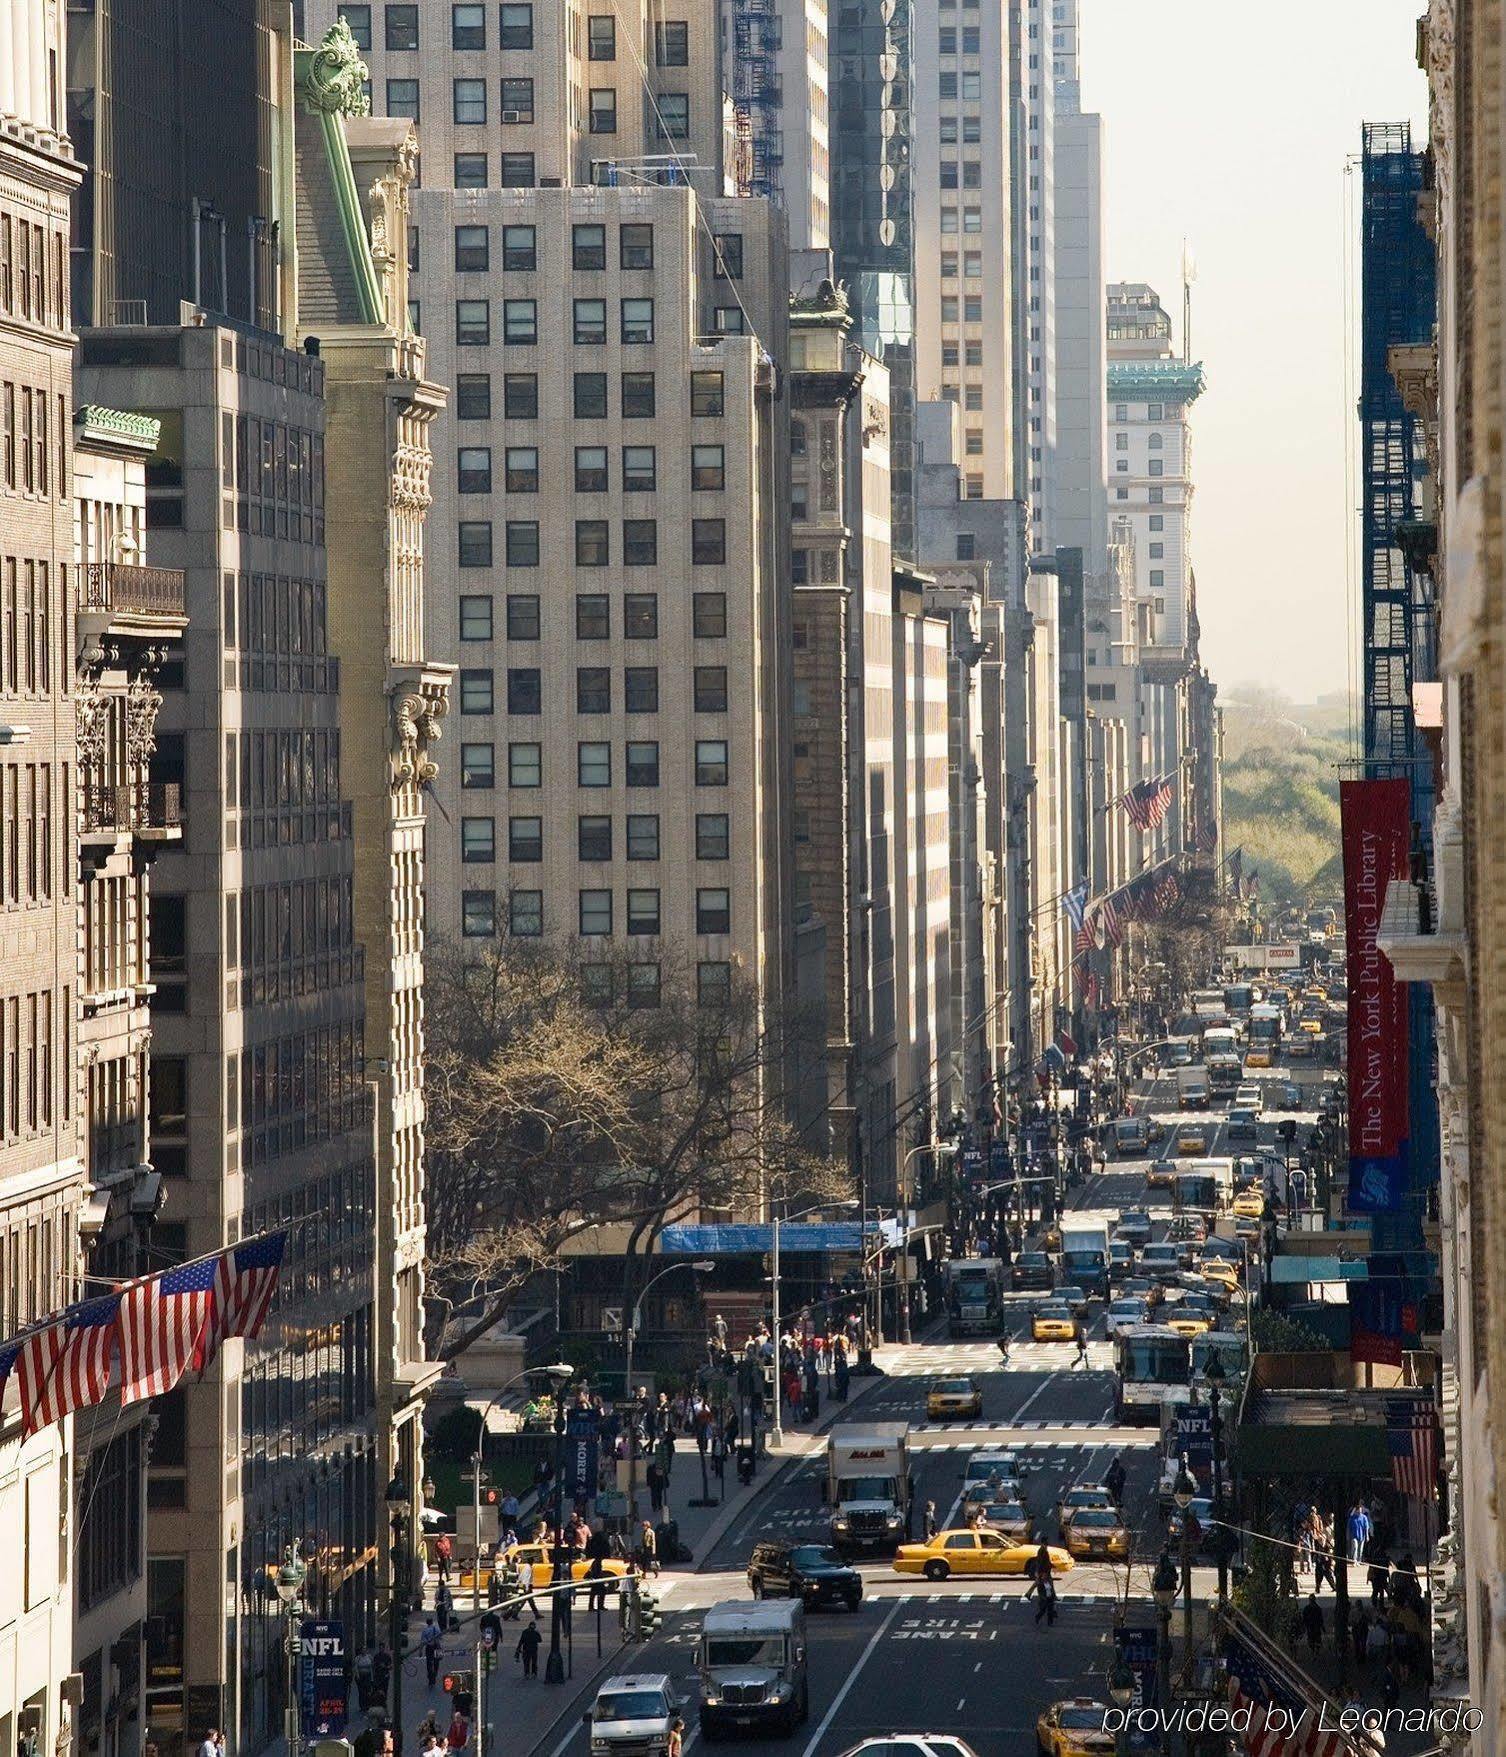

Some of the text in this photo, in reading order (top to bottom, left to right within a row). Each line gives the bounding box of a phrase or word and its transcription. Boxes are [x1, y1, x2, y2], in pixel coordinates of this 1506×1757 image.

[1357, 829, 1382, 1150] The New York Public Library
[964, 1151, 982, 1160] NFL
[1177, 1418, 1211, 1432] NFL
[901, 1619, 985, 1628] FIRE
[890, 1631, 979, 1639] LANE
[301, 1638, 344, 1655] NFL
[303, 1656, 315, 1716] DRAFT
